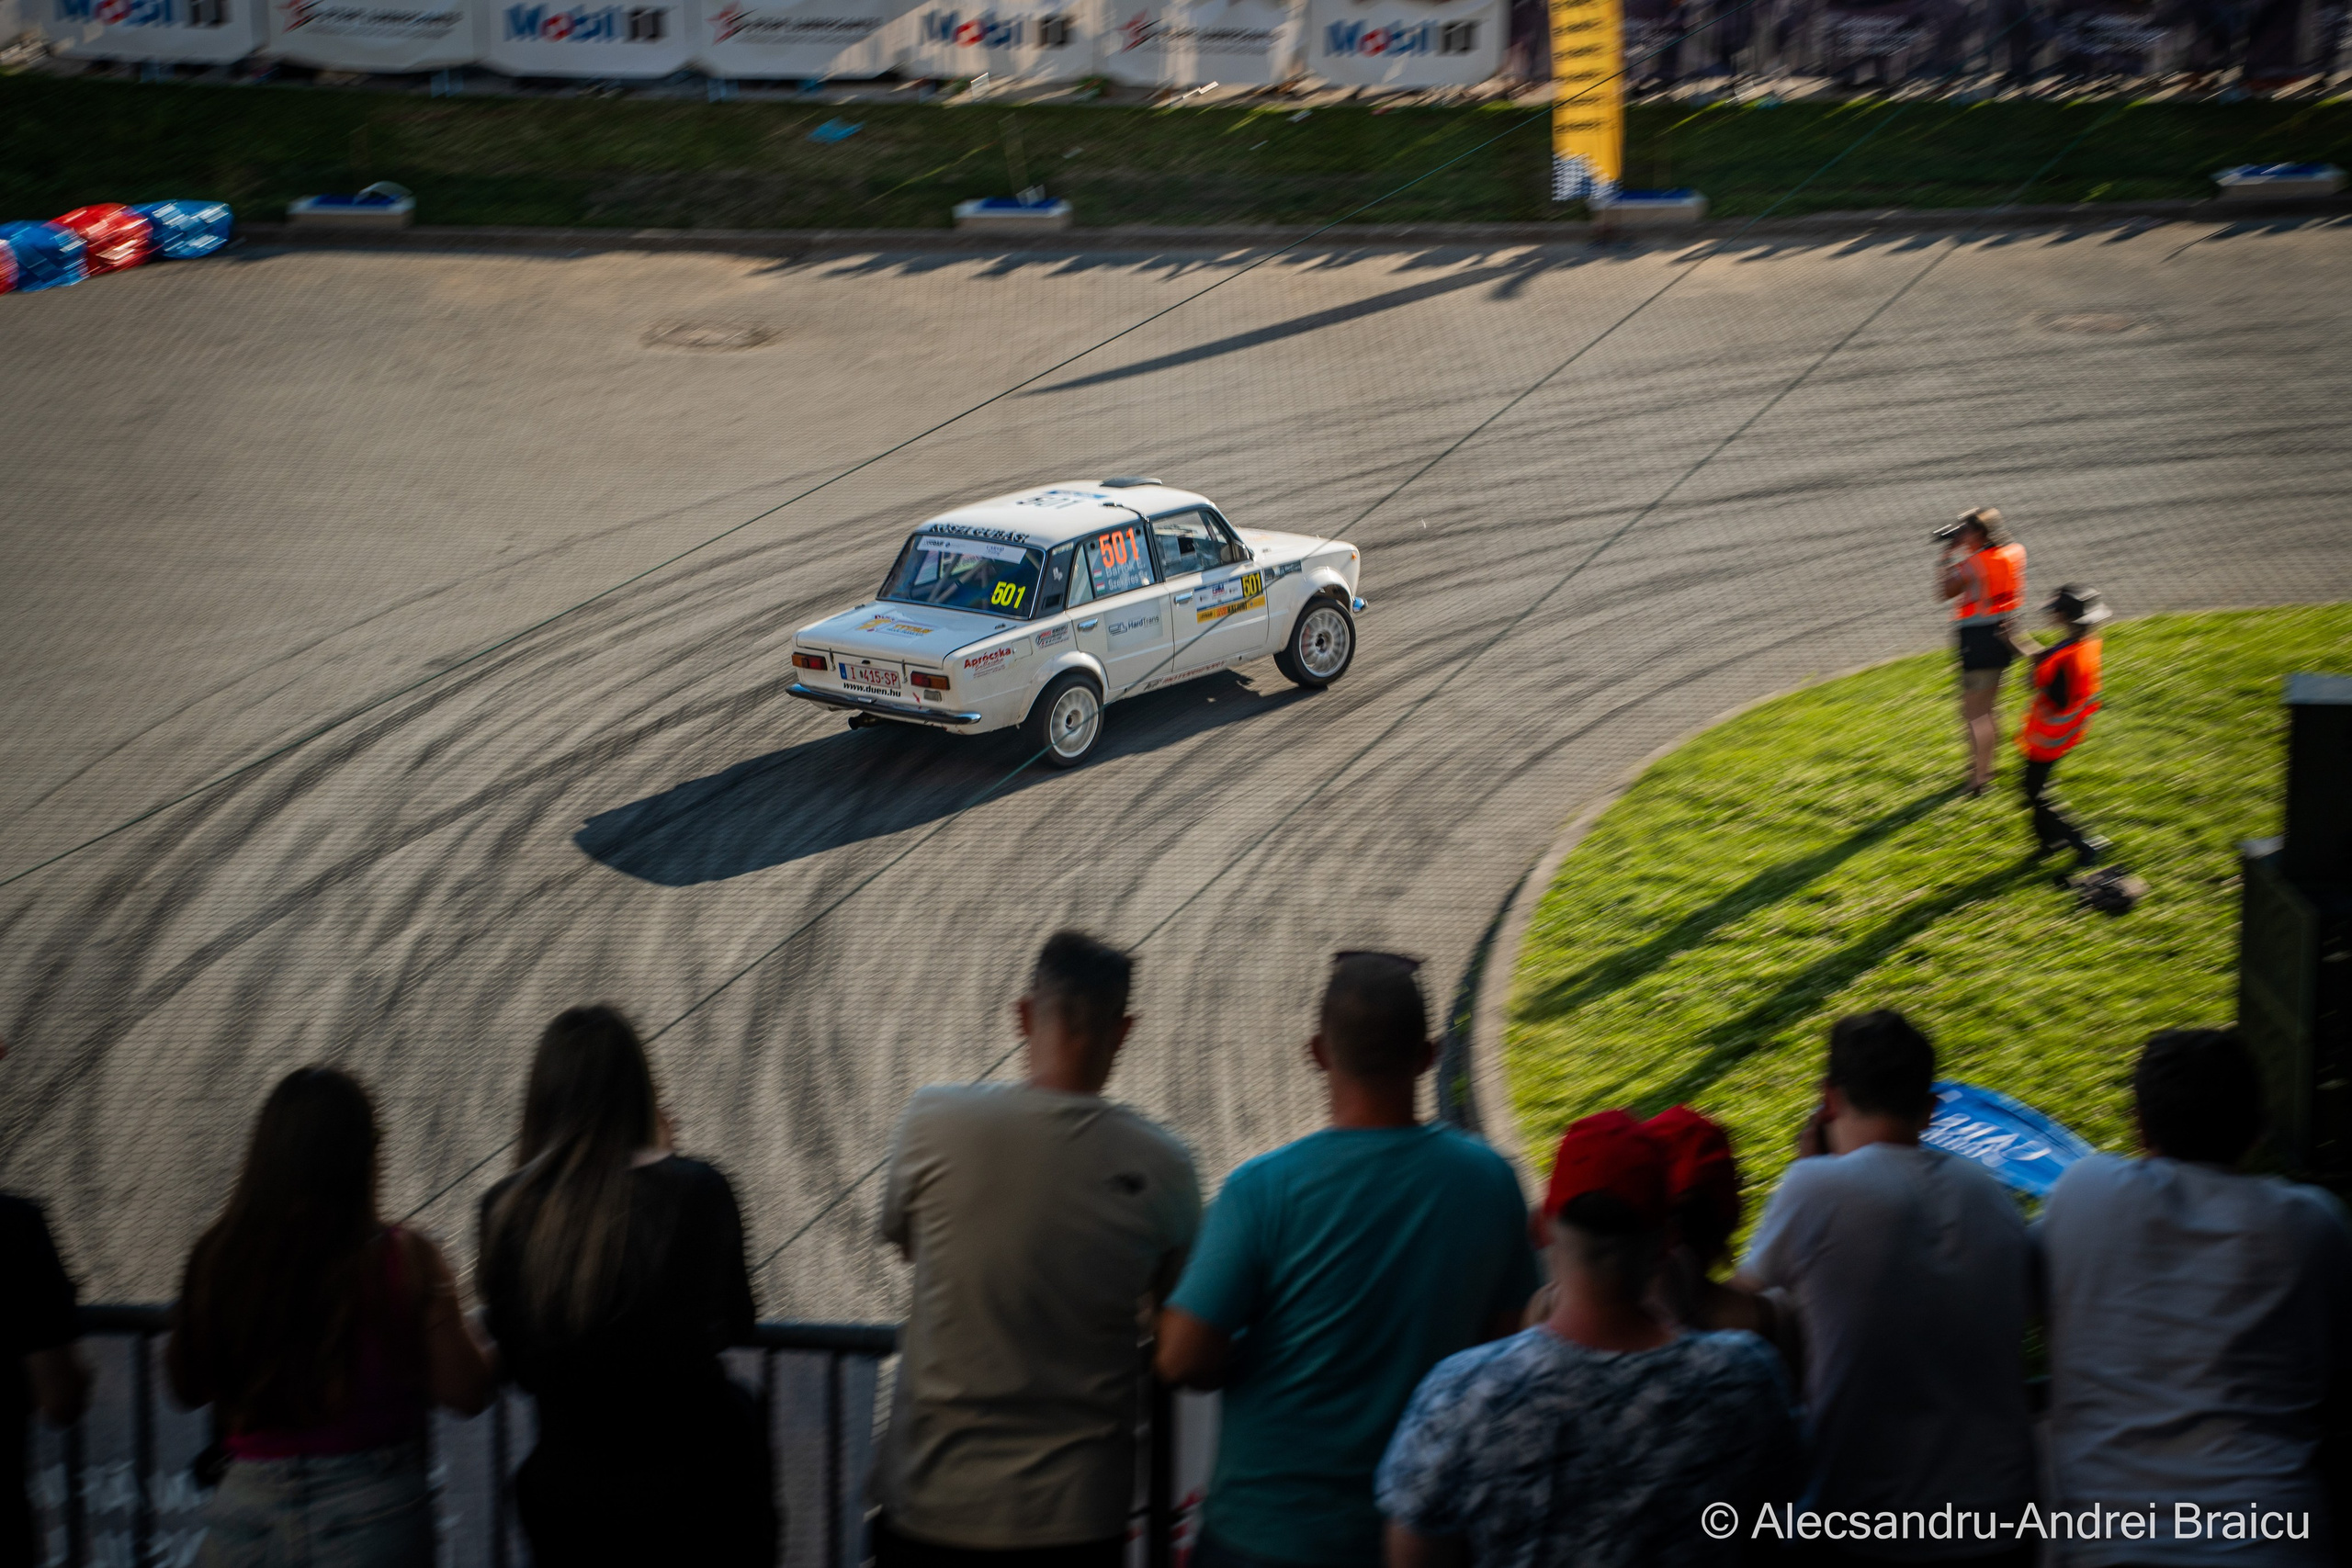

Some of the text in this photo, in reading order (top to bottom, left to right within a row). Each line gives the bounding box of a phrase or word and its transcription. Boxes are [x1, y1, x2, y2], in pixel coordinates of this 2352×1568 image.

[503, 4, 623, 43] Mobil
[921, 9, 1035, 49] Mobil
[1323, 18, 1437, 57] Mobil
[1099, 527, 1140, 569] 501
[990, 581, 1026, 609] 501
[1241, 572, 1262, 598] 501
[1127, 615, 1159, 631] HardTrans
[964, 647, 1012, 670] Aprócska
[843, 682, 901, 698] www.duen.hu
